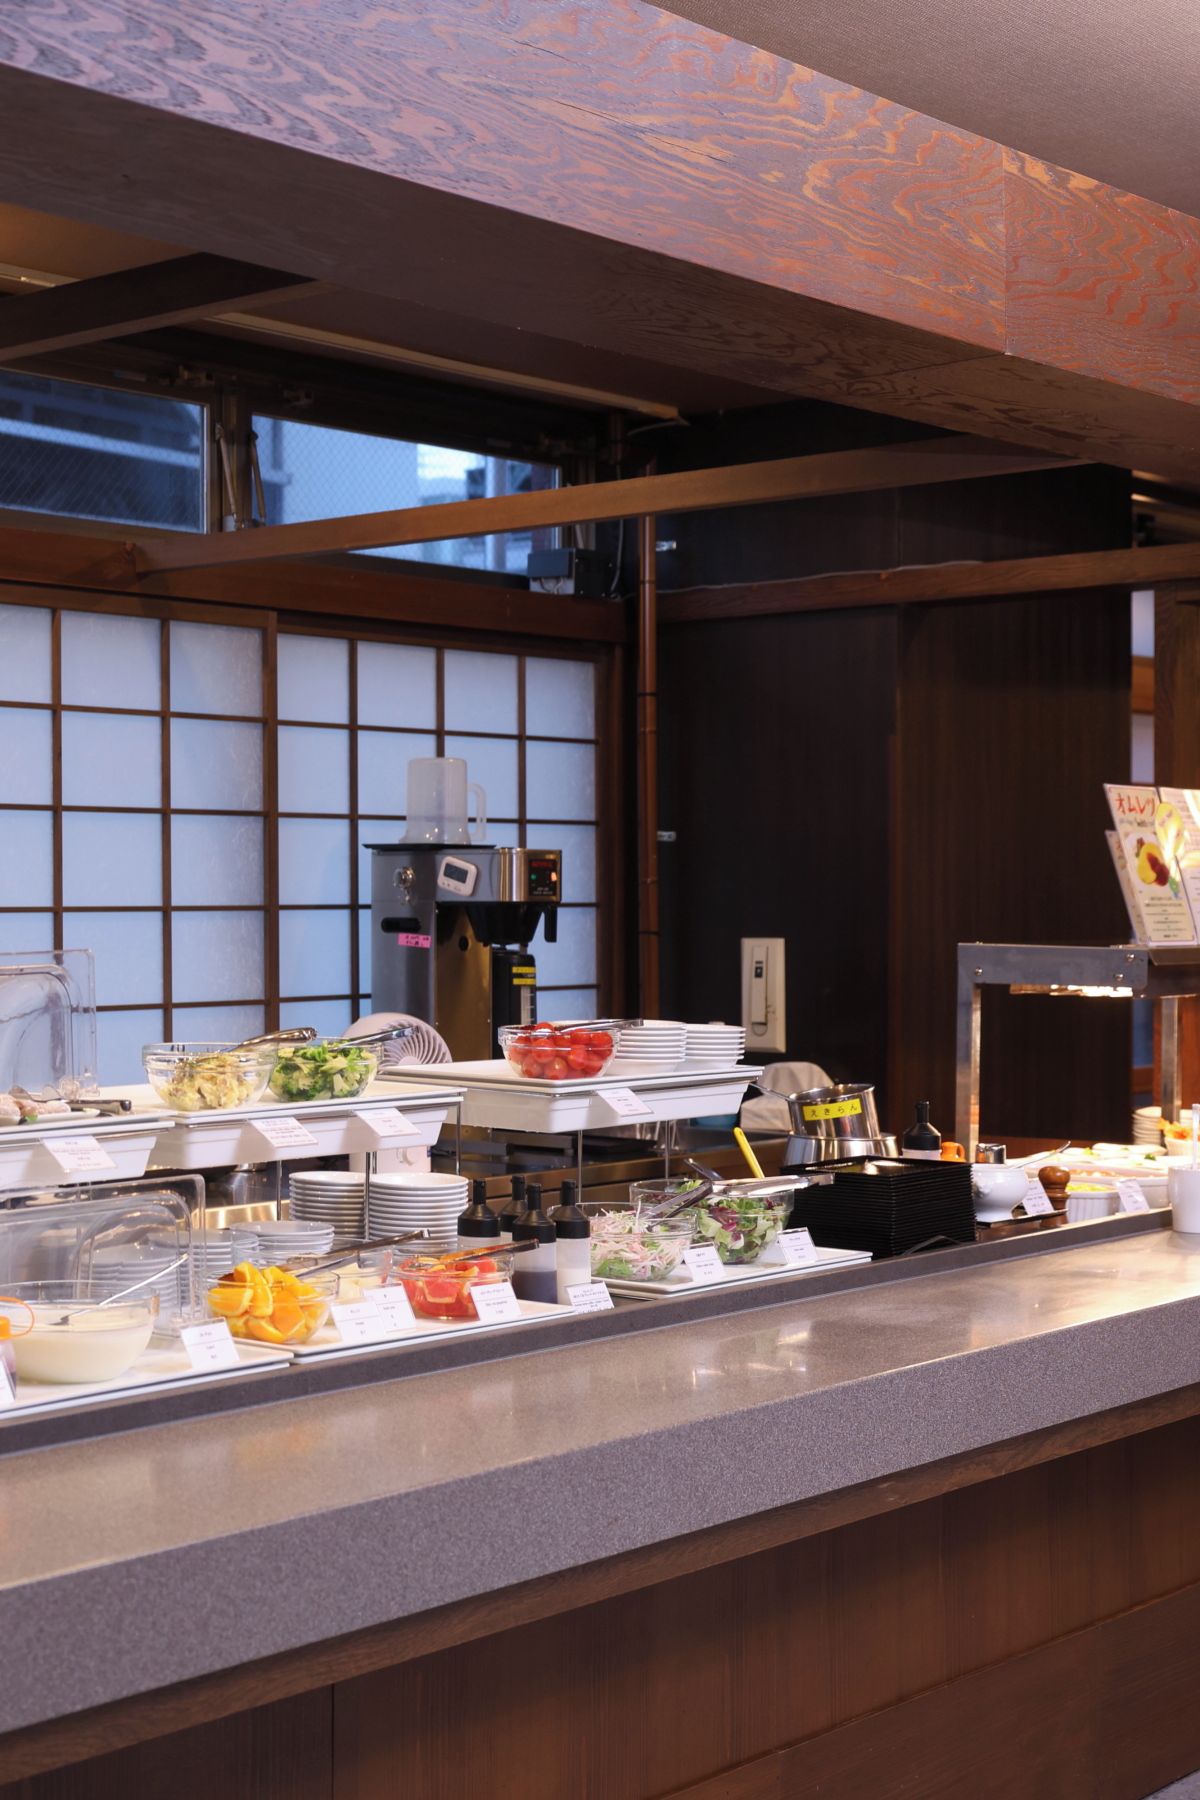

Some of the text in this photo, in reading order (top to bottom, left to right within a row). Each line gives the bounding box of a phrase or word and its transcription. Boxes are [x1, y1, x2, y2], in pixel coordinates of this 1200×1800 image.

[1116, 793, 1155, 816] オムレツ
[810, 1104, 857, 1118] えきらん
